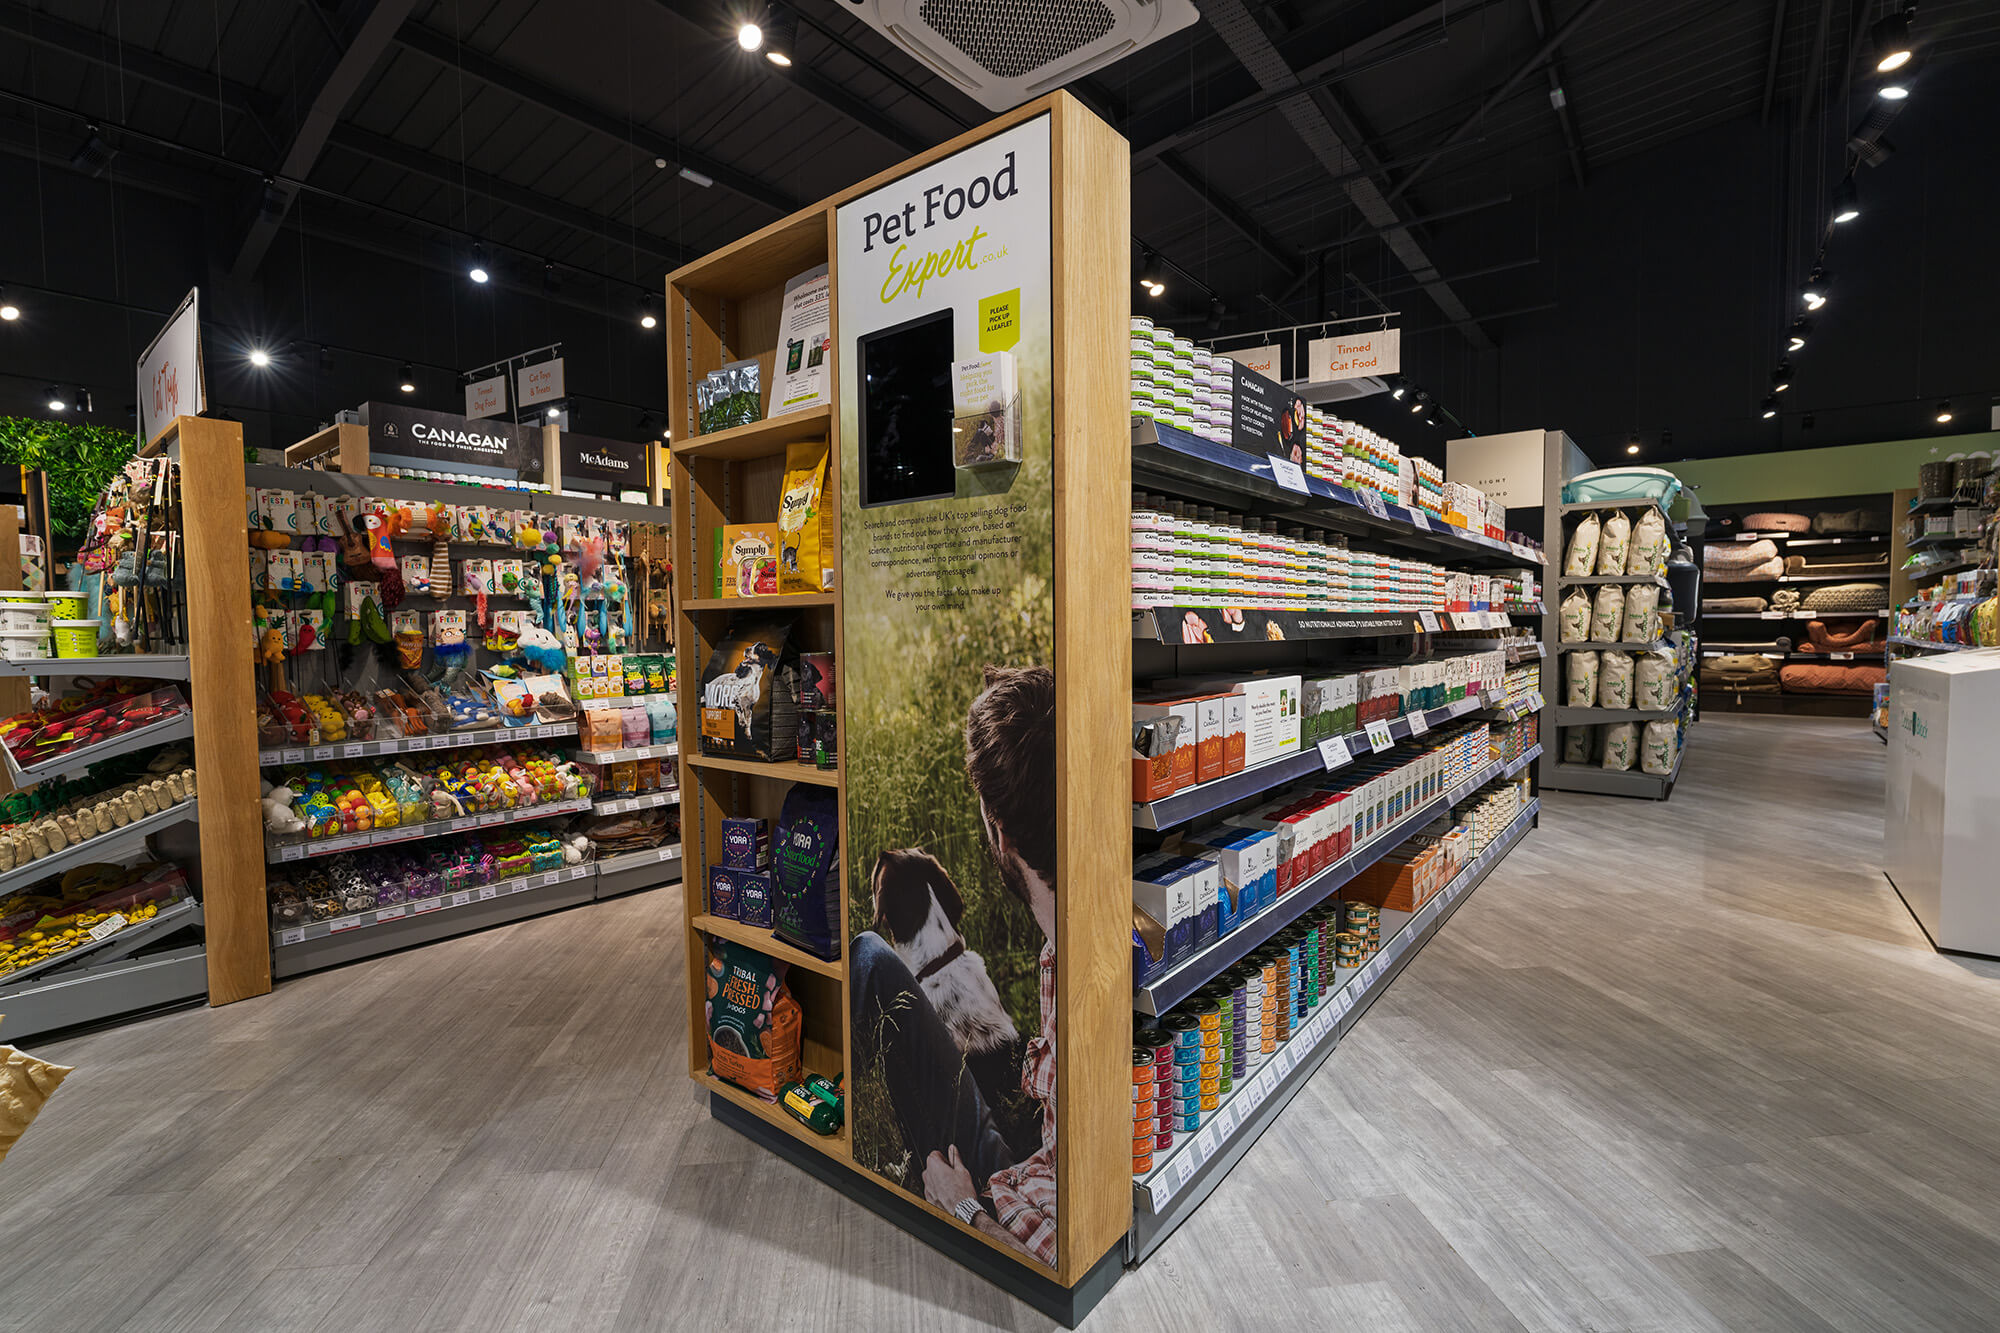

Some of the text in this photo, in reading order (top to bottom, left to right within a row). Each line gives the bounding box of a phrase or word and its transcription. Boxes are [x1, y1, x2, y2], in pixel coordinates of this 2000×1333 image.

[863, 151, 1019, 253] Pet Food
[880, 225, 1009, 304] Expert .co.uk
[990, 304, 1009, 315] PLEASE
[989, 312, 1010, 323] PICK UP
[991, 320, 1013, 331] LEAFLET
[1337, 341, 1372, 356] Tinned
[1247, 360, 1271, 372] Food
[1330, 357, 1377, 372] Cat Food
[528, 370, 551, 382] Cat Toys
[152, 360, 179, 418] Cat Toys
[477, 384, 493, 396] Tinned
[530, 385, 551, 397] & Treats
[1240, 376, 1265, 395] CANAGAN
[474, 397, 497, 411] Dog Food
[411, 423, 508, 450] CANAGAN
[473, 446, 504, 455] ANCESTORS
[579, 452, 630, 470] McAdams
[261, 496, 290, 505] FESTA
[294, 500, 322, 509] FIESA
[782, 492, 809, 512] Symply
[490, 513, 508, 522] FIESTA
[864, 503, 1027, 530] Search and compare the UK's top selling dog food
[873, 521, 1016, 542] brands to find out how they score, based on
[735, 544, 766, 556] Symply
[868, 534, 1022, 556] science, nutritional expertise and manufacturer
[272, 555, 299, 565] FIESA
[871, 549, 1019, 569] correspondence, with no personal opinions or
[405, 561, 427, 570] FIESTA
[497, 564, 520, 572] FIESTA
[905, 567, 976, 580] advertising messages.
[354, 587, 379, 596] FIESTA
[885, 586, 1001, 602] We give you the facts. You make up
[915, 601, 965, 614] your own mind.
[395, 617, 417, 625] FIESTA
[439, 615, 463, 623] FIESTA
[705, 683, 739, 708] MORE
[729, 835, 748, 844] YORA
[793, 832, 812, 850] YORA
[715, 881, 731, 892] YORA
[745, 889, 763, 899] YORA
[730, 975, 756, 995] FRESH
[722, 982, 760, 1010] PRESSED
